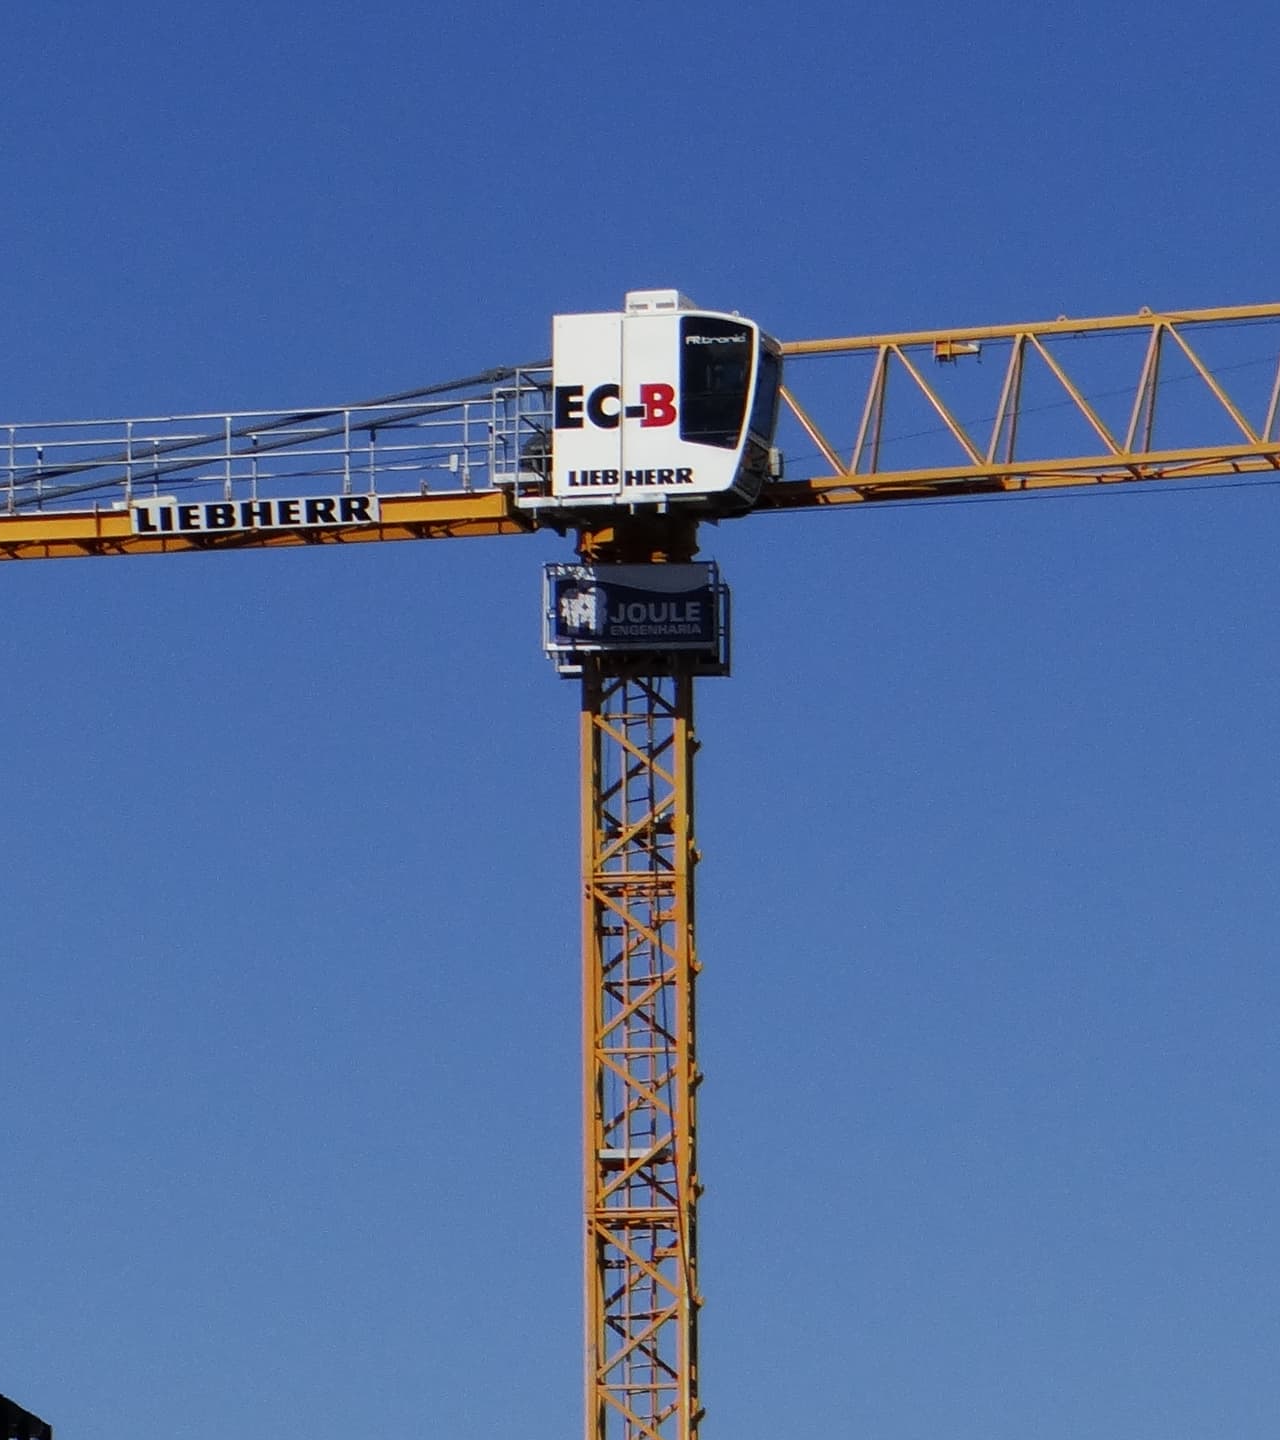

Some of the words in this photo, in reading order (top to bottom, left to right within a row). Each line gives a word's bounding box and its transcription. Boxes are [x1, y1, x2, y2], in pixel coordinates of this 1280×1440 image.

[555, 383, 677, 429] EC-B
[568, 467, 693, 487] LIEBHERR
[137, 500, 371, 533] LIEBHERR
[610, 602, 702, 623] JOULE
[610, 624, 702, 636] ENGENHARIA
